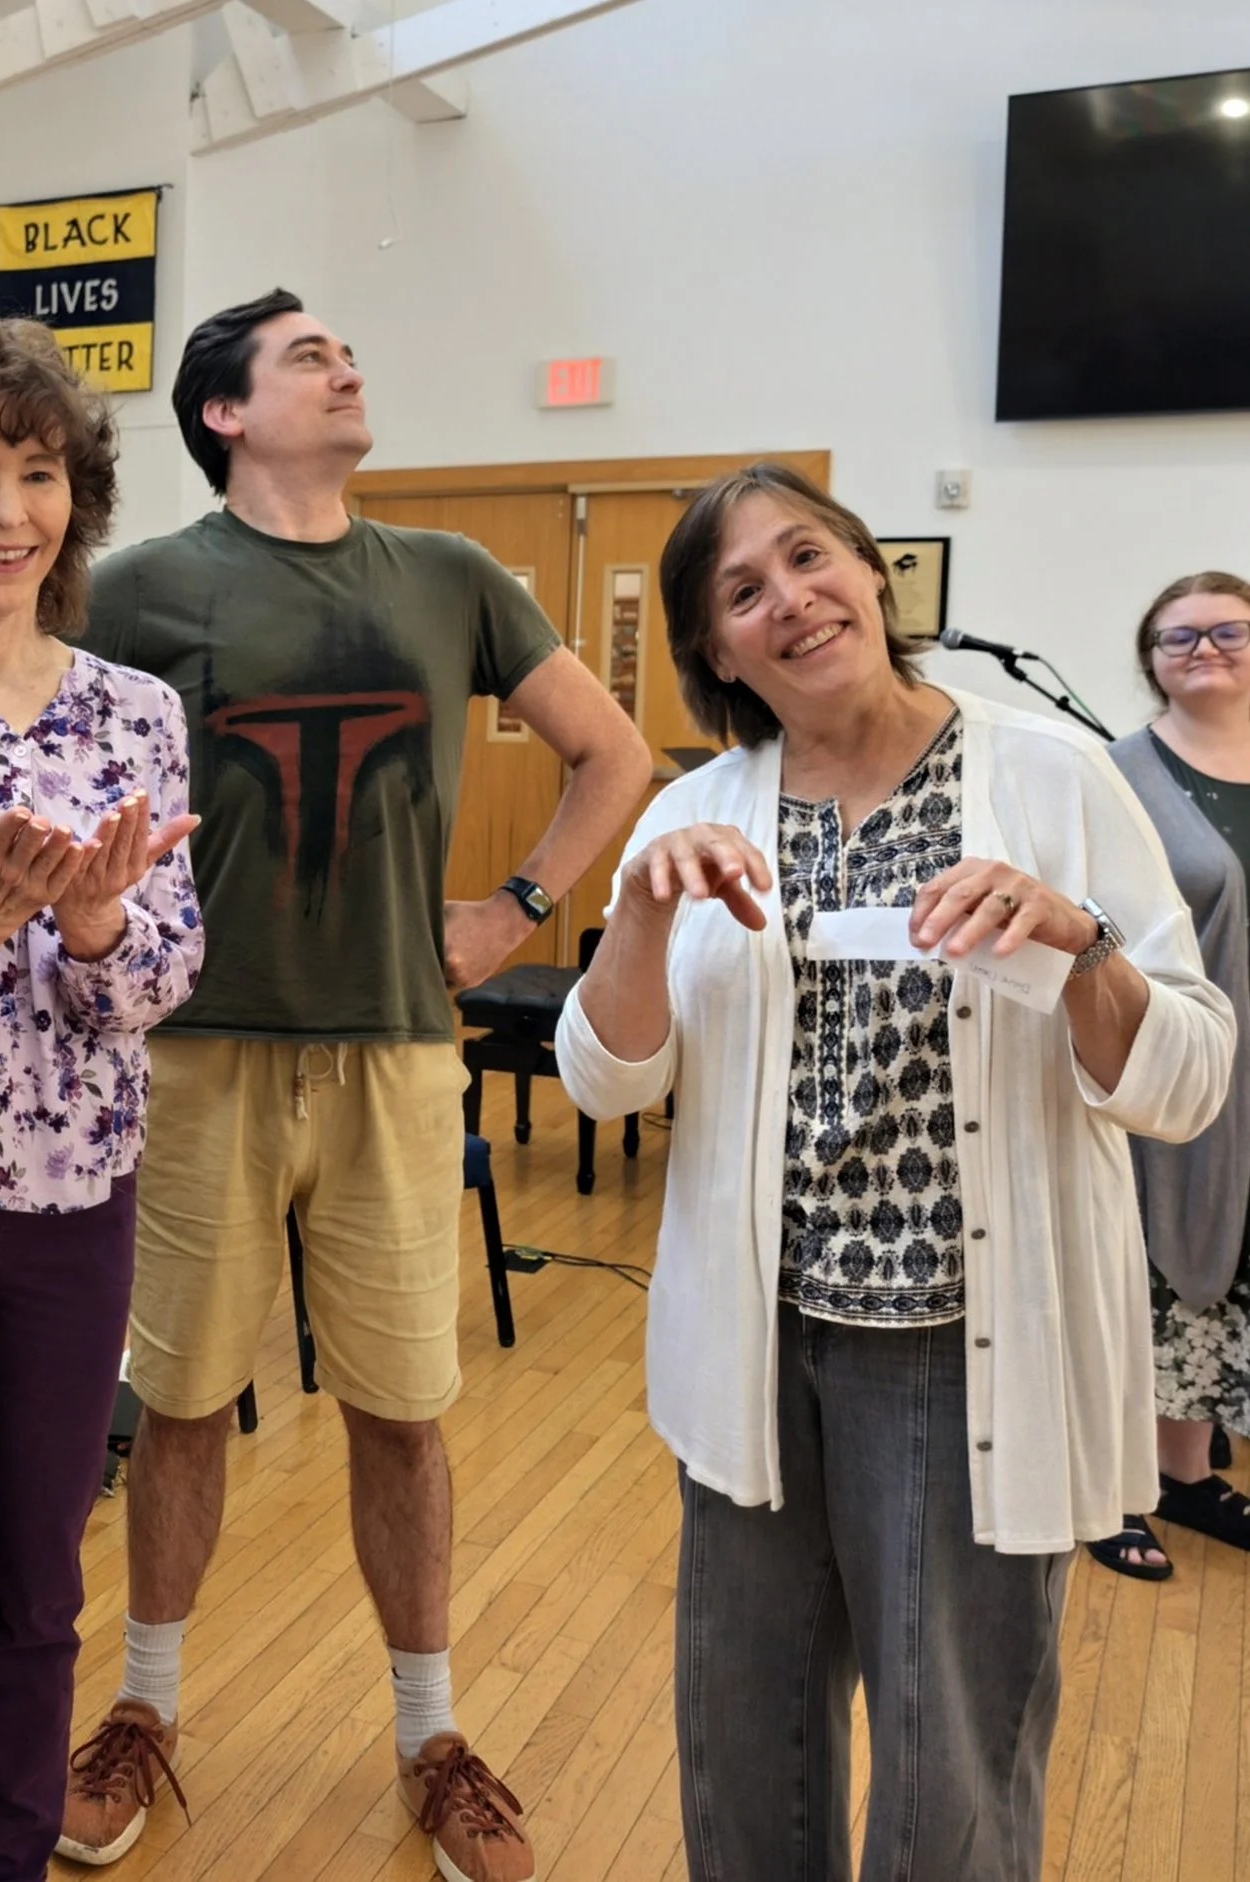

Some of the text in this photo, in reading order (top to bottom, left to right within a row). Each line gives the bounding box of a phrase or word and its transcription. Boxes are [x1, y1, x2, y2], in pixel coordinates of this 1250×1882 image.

[24, 213, 131, 253] BLACK
[35, 278, 119, 316] LIVES
[62, 340, 135, 372] TTER
